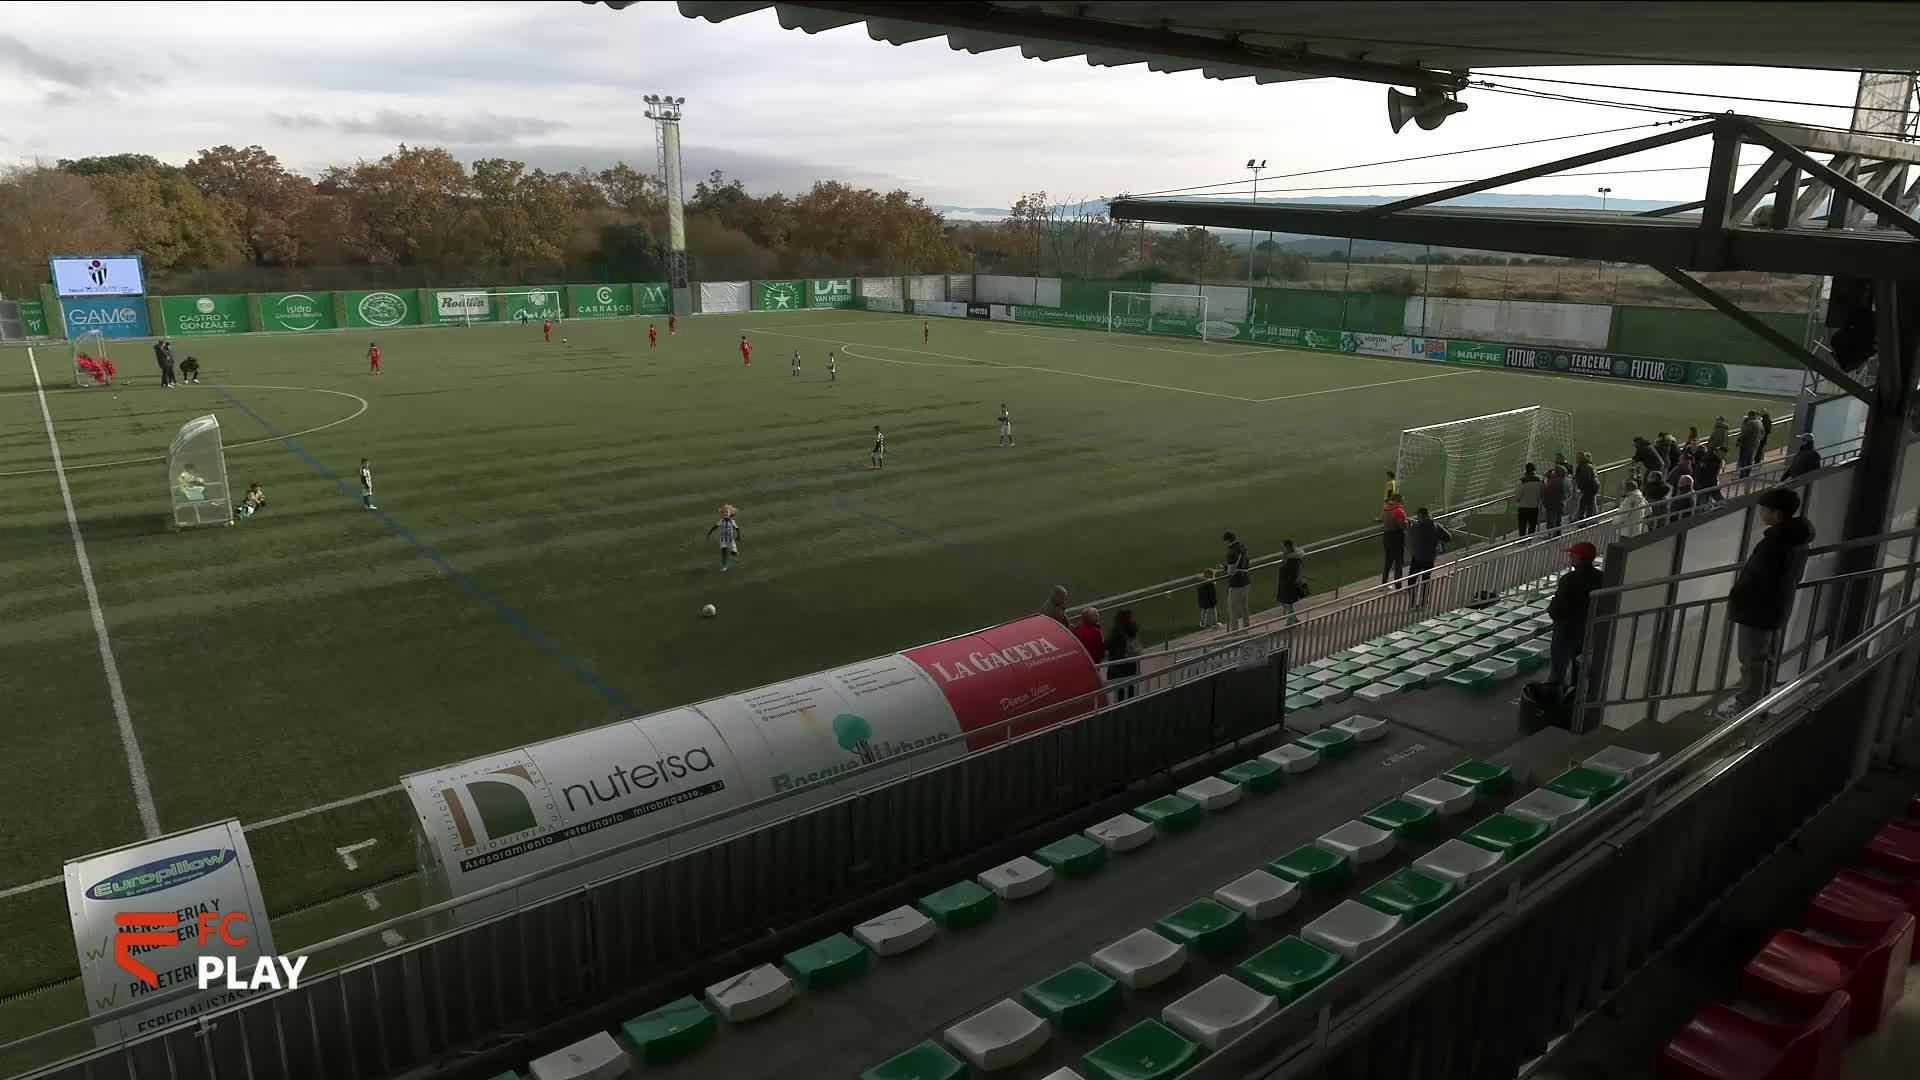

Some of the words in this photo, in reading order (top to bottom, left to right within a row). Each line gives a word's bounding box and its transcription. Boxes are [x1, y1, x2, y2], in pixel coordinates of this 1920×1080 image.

[578, 304, 632, 312] CARRASCO
[179, 314, 221, 322] CASTRO
[1457, 350, 1501, 362] MAPFRE
[1571, 355, 1611, 370] TERCERA
[931, 661, 976, 682] LA
[969, 638, 1060, 672] GACETA
[562, 747, 715, 811] nutersa
[464, 837, 553, 871] Asesoramiento
[563, 813, 623, 840] veterinario
[93, 847, 226, 897] Europillow
[211, 898, 220, 912] Y
